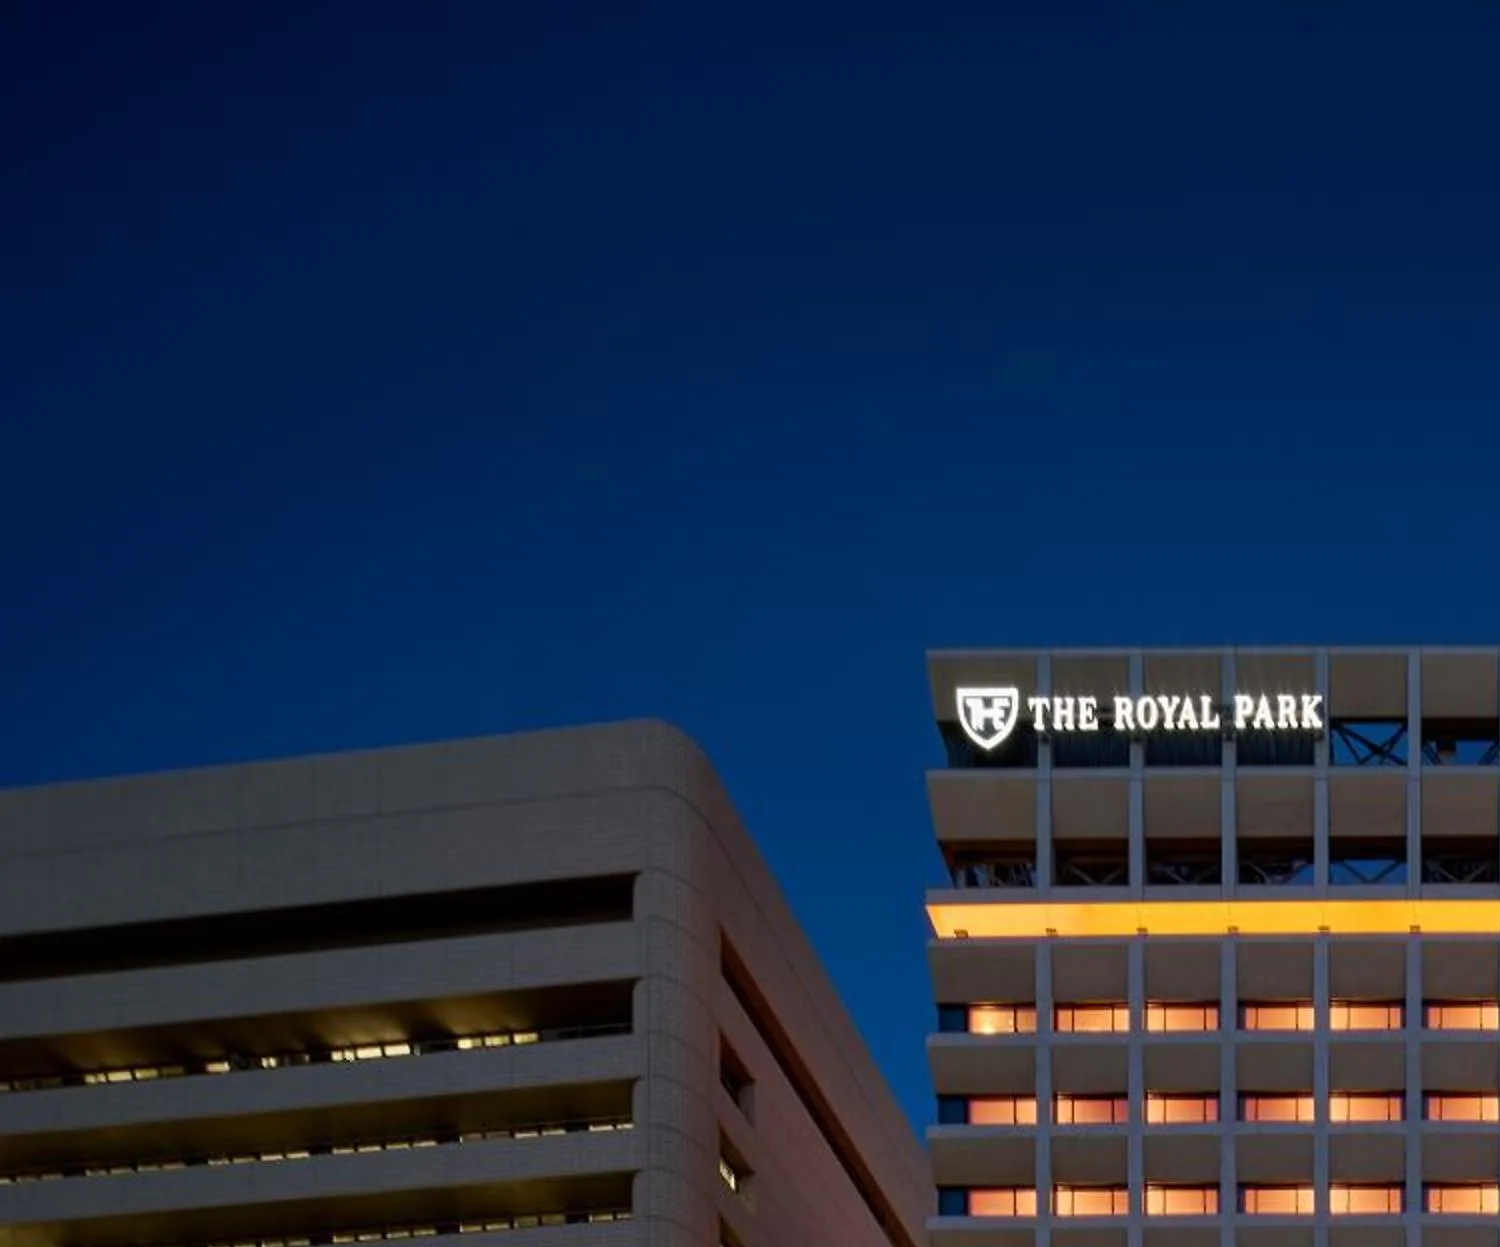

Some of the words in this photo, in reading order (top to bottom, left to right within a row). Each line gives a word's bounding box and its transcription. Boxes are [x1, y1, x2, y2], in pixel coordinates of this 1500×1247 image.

[1027, 696, 1099, 731] THE
[1113, 694, 1221, 730] ROYAL
[1233, 693, 1323, 729] PARK
